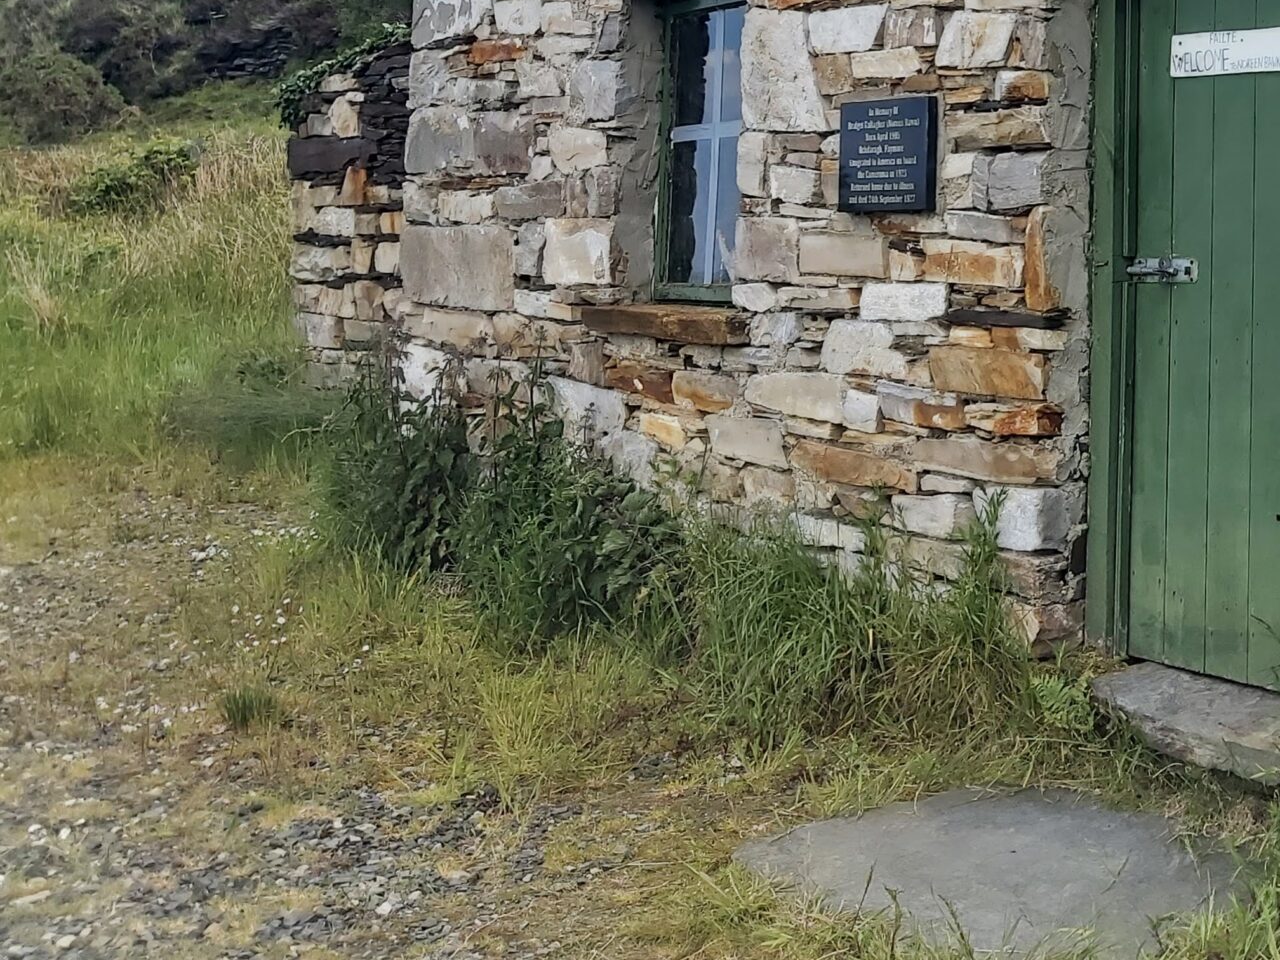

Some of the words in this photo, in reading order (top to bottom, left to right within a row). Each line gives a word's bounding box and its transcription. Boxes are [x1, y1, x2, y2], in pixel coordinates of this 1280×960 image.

[875, 107, 892, 117] Memory
[877, 132, 888, 142] April
[851, 183, 870, 191] Returned
[871, 183, 883, 191] home
[884, 183, 892, 191] due
[880, 195, 903, 204] September
